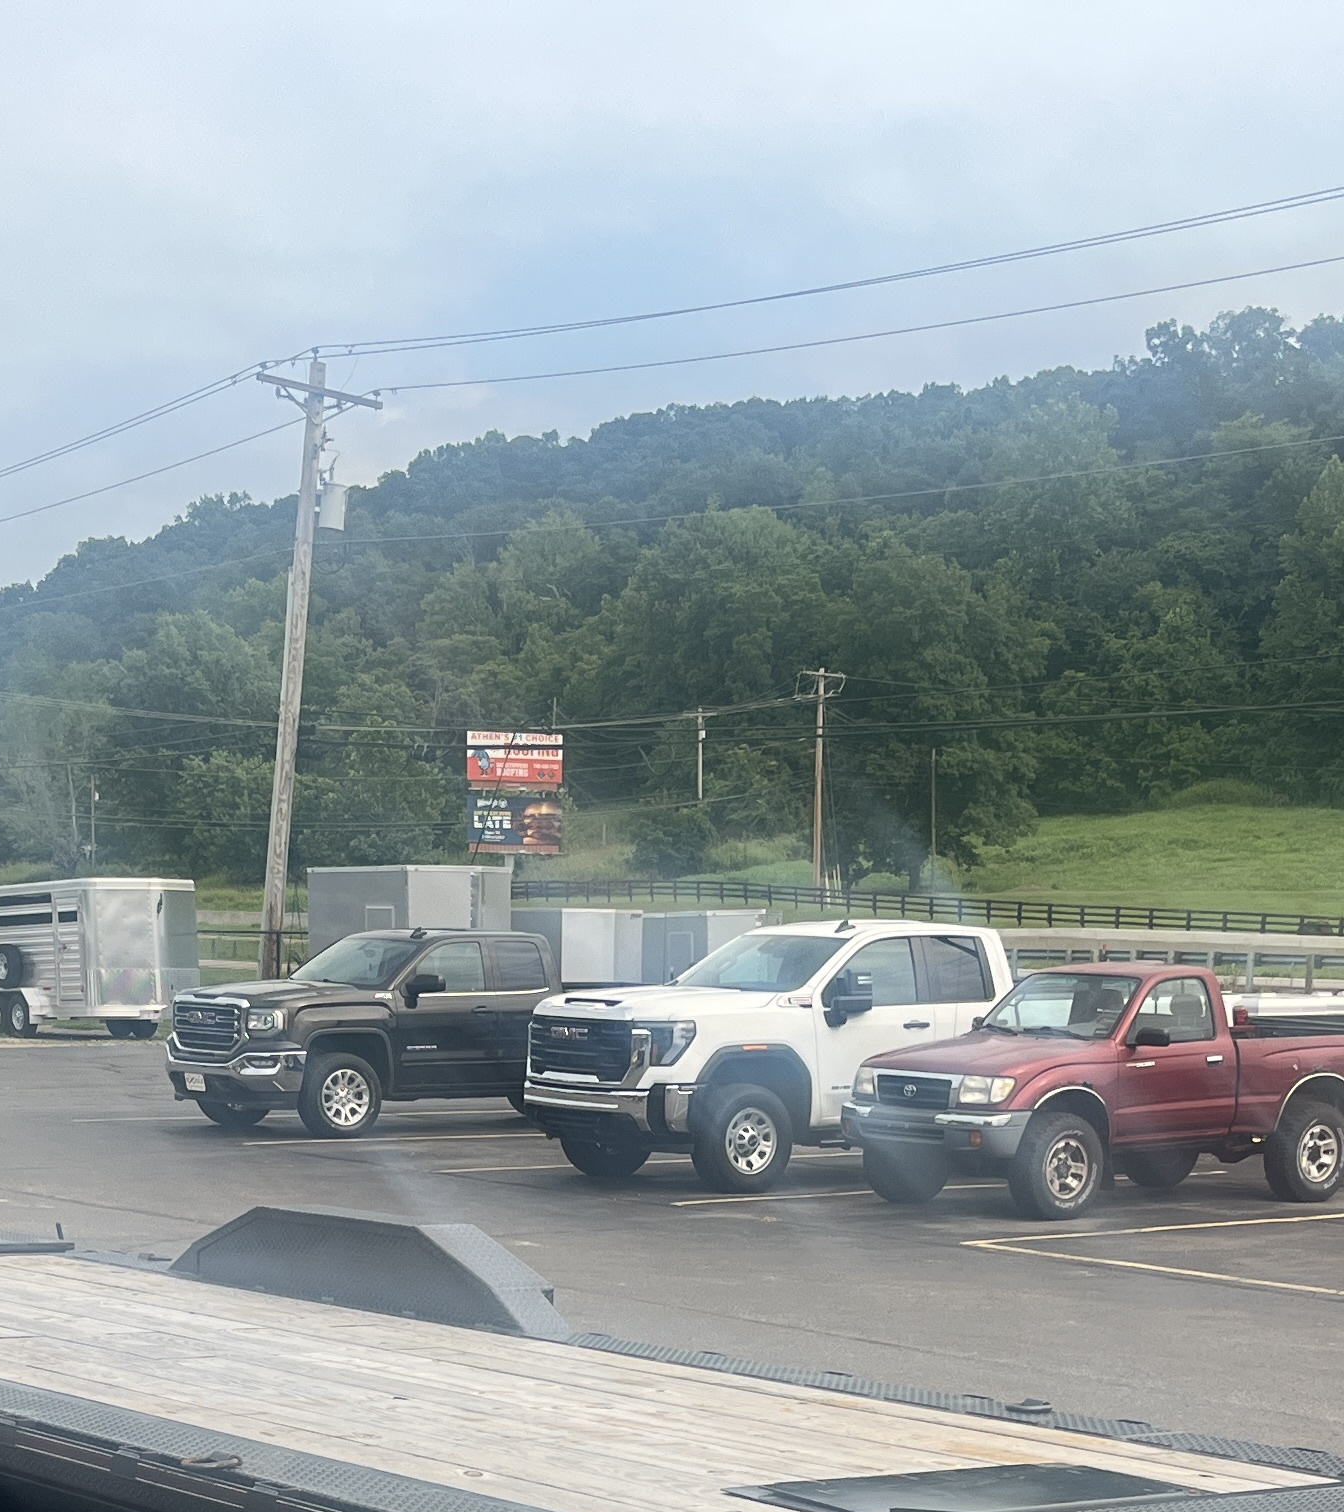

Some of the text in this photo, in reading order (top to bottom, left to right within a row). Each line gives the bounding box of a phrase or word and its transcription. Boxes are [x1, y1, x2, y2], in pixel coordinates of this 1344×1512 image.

[470, 732, 510, 741] ATHEN'S
[525, 734, 559, 743] CHOICE
[474, 815, 512, 829] LATE
[551, 1026, 588, 1041] GMC
